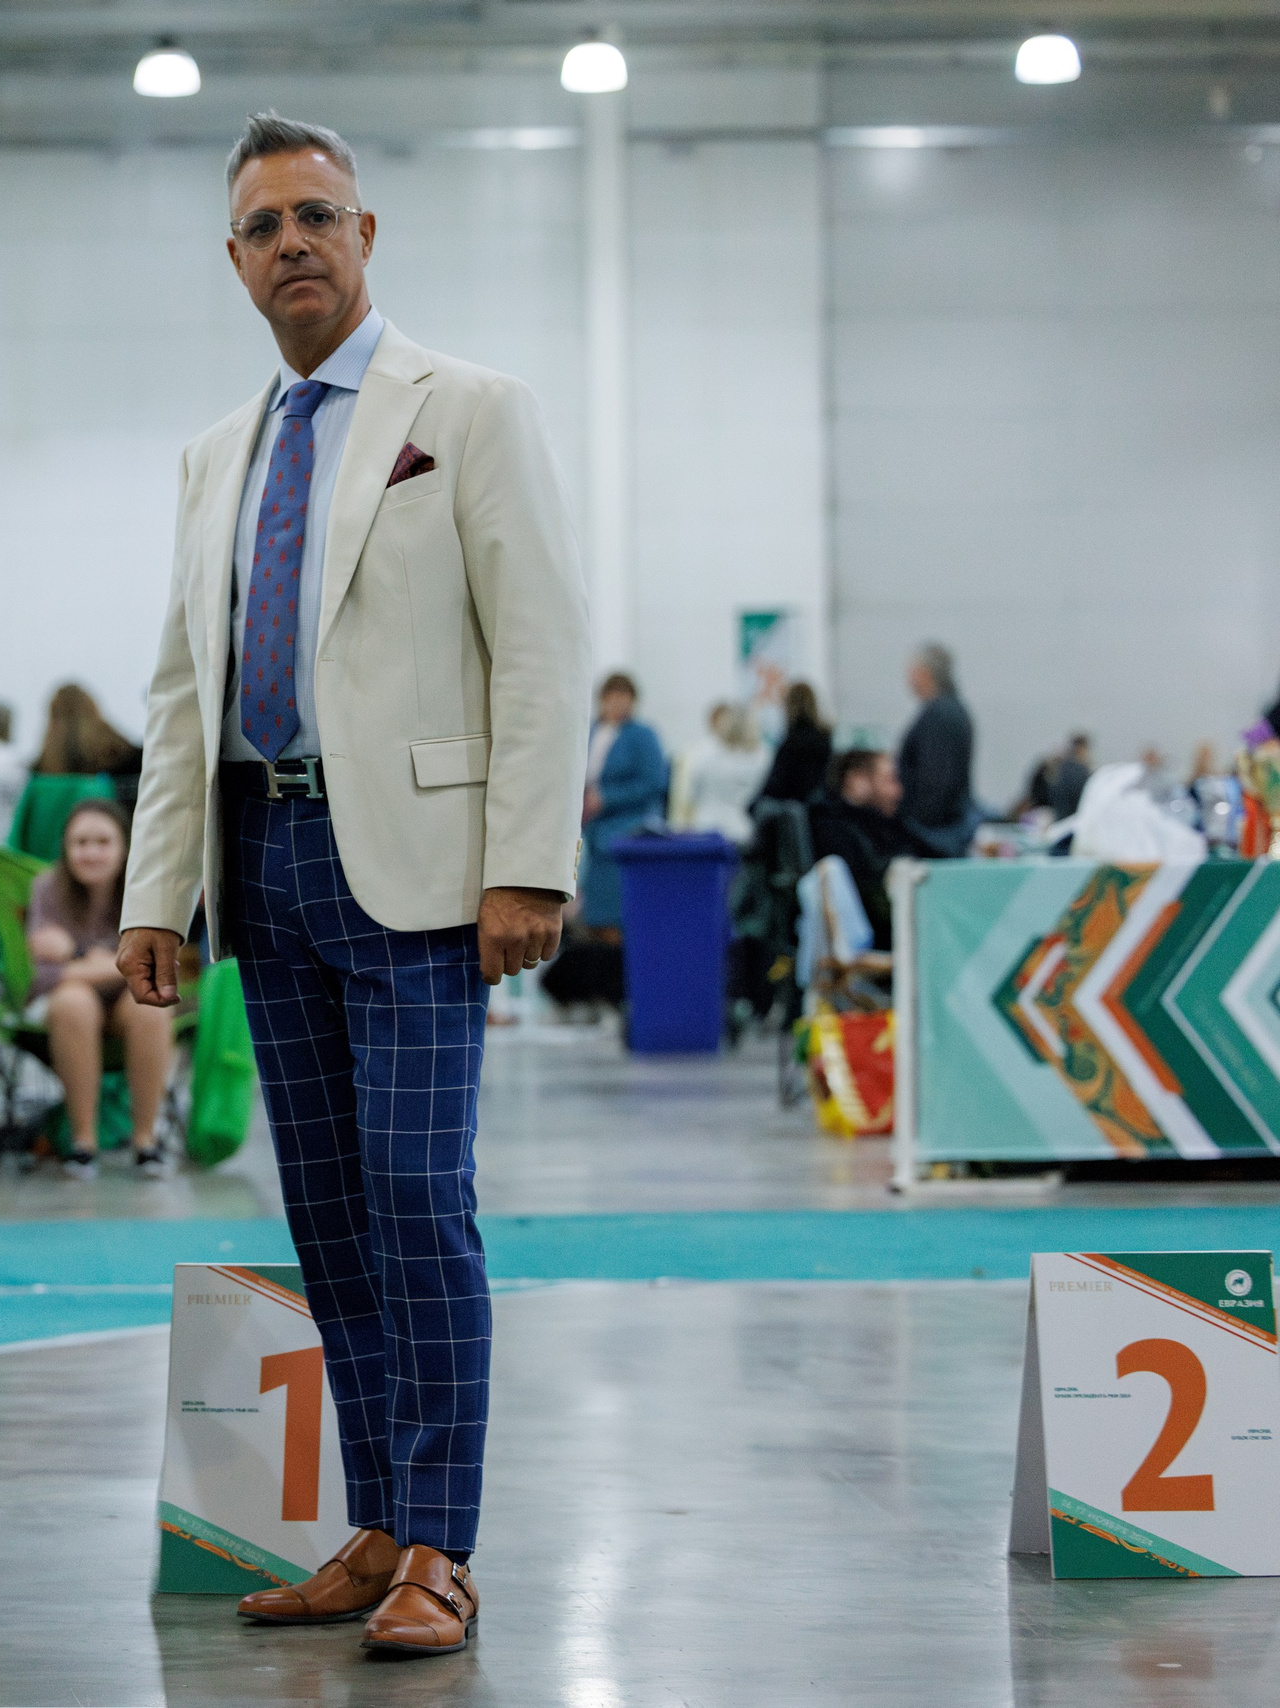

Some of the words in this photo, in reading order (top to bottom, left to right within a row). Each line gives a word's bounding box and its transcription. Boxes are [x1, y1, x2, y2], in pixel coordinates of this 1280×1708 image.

[187, 1294, 252, 1306] PREMIER
[1049, 1281, 1113, 1292] PREMIER
[259, 1346, 323, 1521] 1
[1116, 1338, 1215, 1512] 2
